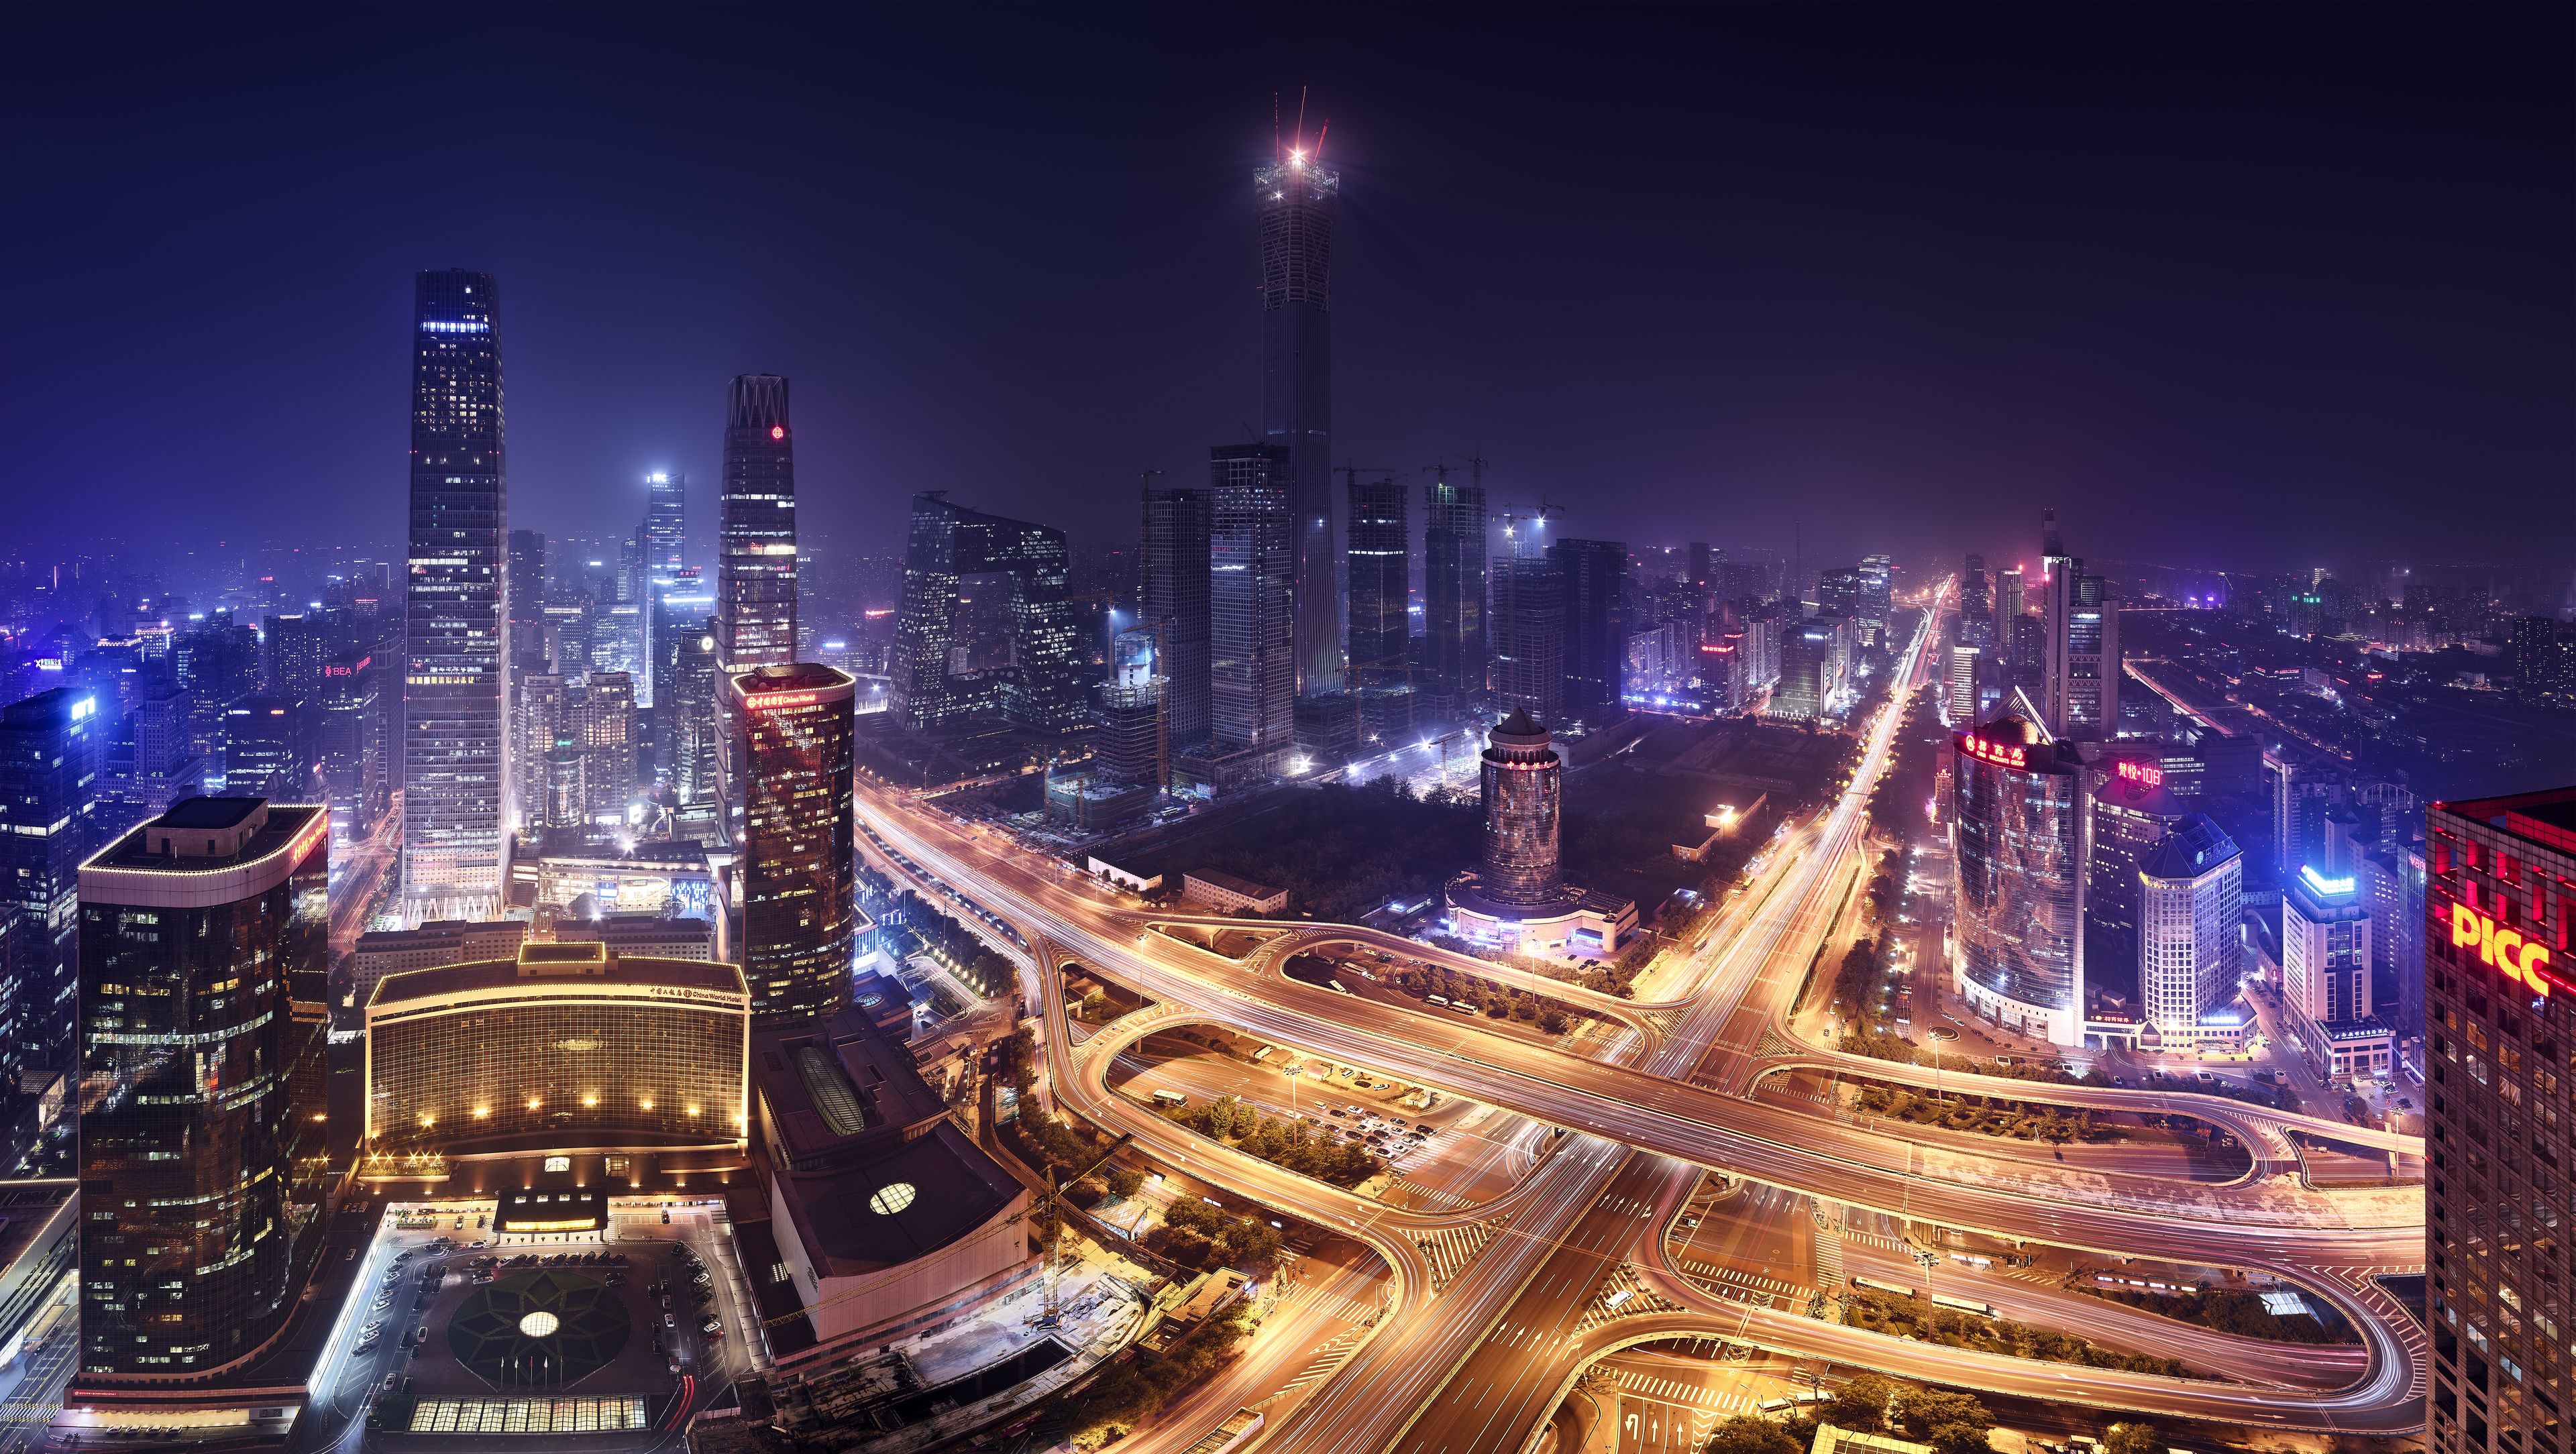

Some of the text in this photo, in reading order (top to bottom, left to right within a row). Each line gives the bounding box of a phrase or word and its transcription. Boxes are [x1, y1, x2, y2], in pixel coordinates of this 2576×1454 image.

[333, 667, 352, 675] BEA
[783, 695, 799, 704] China
[1978, 740, 2023, 760] 招商局
[1976, 750, 1986, 759] CHINA
[1989, 754, 2010, 765] MERCHANTS
[1507, 761, 1550, 771] 中国恒天
[2453, 902, 2549, 997] PICC
[692, 991, 742, 1003] China World Hotel
